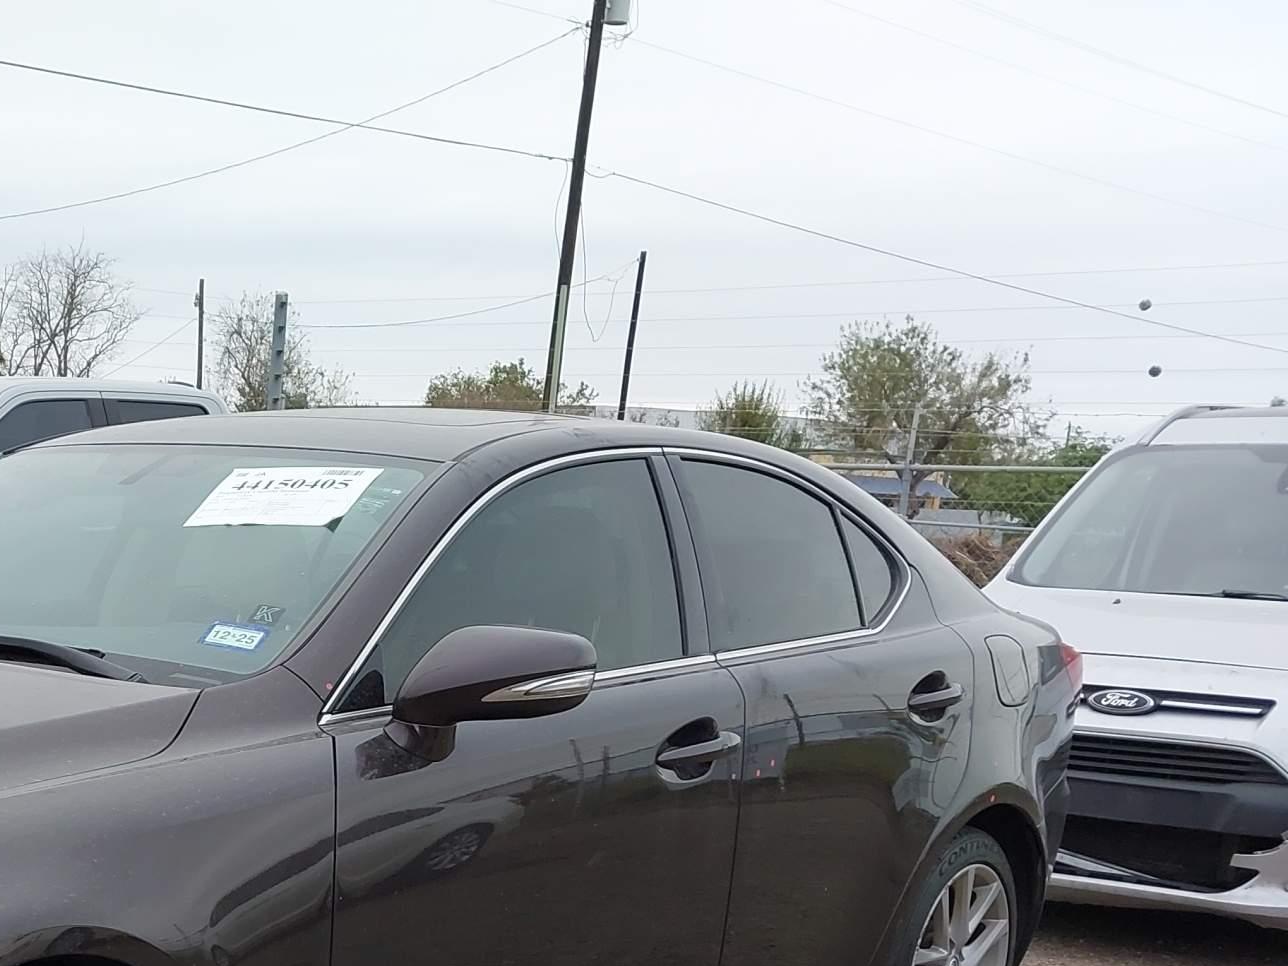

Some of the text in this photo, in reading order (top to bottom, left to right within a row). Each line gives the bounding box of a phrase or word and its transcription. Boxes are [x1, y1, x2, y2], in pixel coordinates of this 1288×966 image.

[232, 478, 353, 491] 44150405
[253, 605, 281, 623] K
[1101, 693, 1139, 707] Ford
